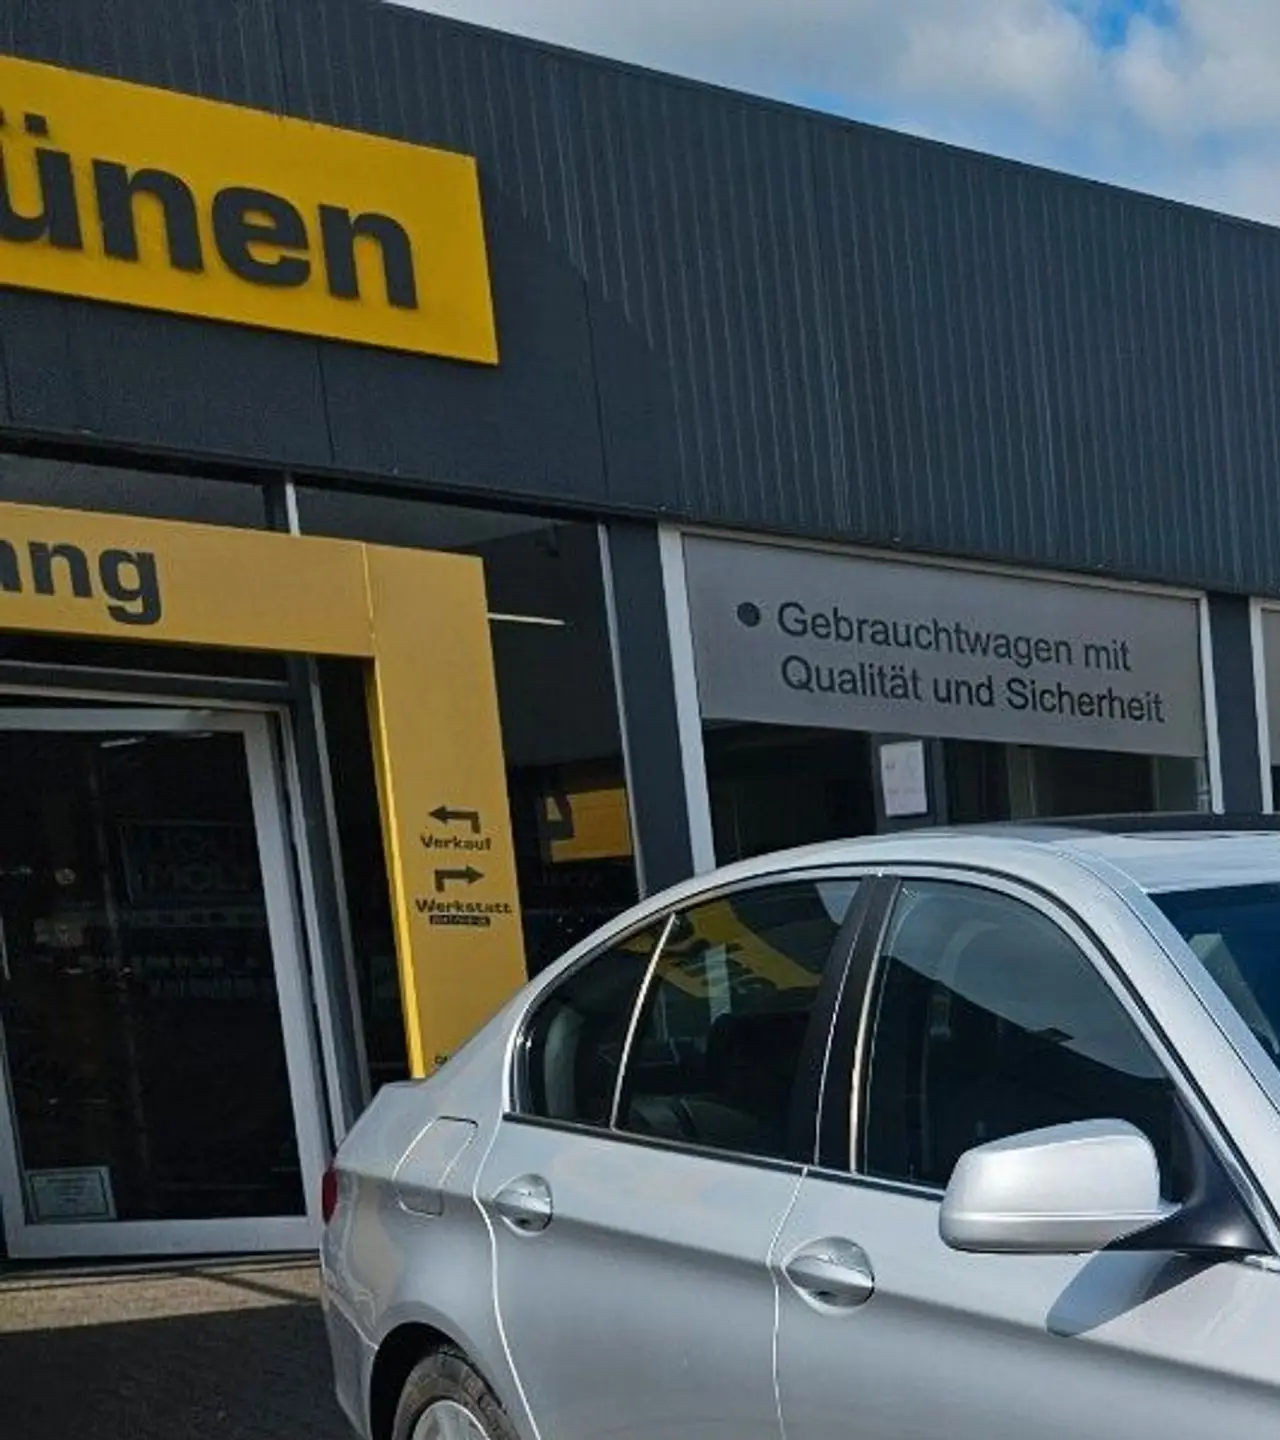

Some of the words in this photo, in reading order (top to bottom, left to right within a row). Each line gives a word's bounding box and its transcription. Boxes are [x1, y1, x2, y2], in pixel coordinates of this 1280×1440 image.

[777, 601, 1073, 669] Gebrauchtwagen
[1083, 637, 1132, 673] mit
[781, 655, 923, 702] Qualität
[932, 674, 995, 708] und
[1006, 677, 1165, 724] Sicherheit
[420, 833, 492, 851] Verkauf
[415, 899, 512, 914] Werkstatt
